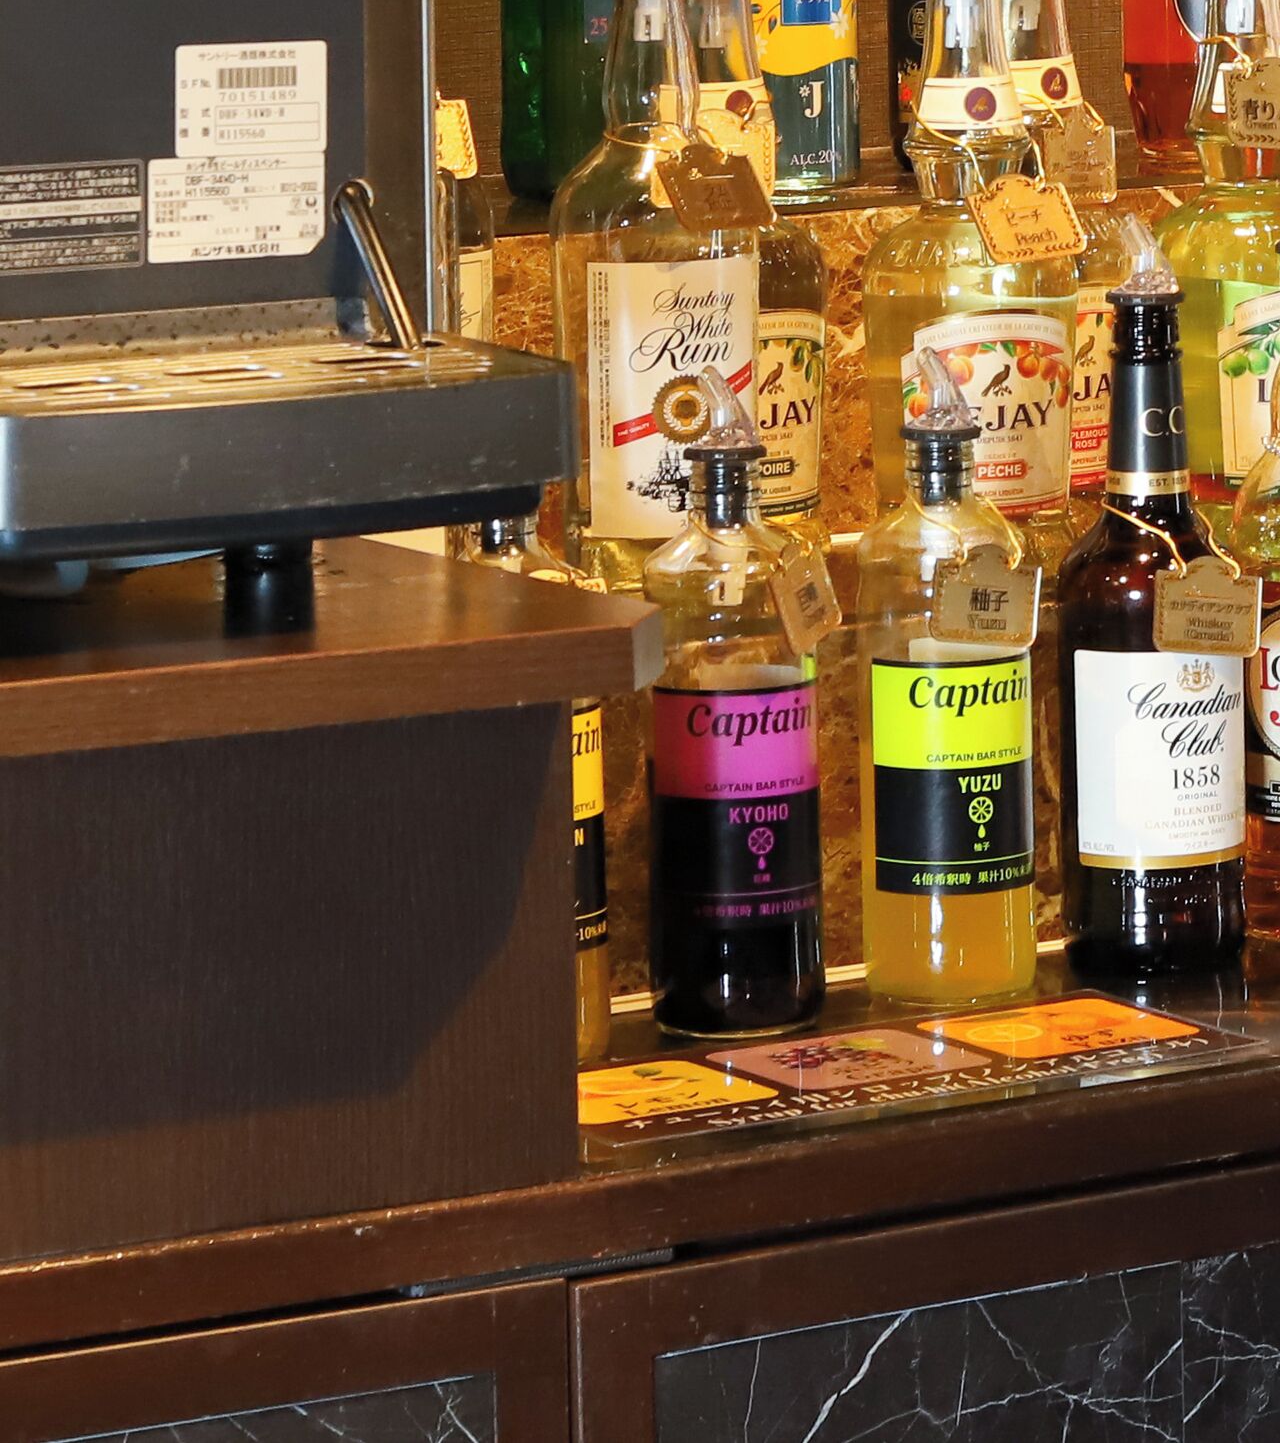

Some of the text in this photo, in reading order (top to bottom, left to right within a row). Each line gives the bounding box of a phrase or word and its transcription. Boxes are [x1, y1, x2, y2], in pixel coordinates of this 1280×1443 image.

[1014, 227, 1058, 246] Peach
[652, 282, 737, 321] Suntory
[673, 310, 734, 343] White
[628, 327, 735, 374] Rum
[760, 395, 817, 431] JAY
[1074, 439, 1098, 450] ROSE
[969, 587, 1010, 613] 柚子
[1185, 618, 1235, 631] Whiskey
[908, 669, 1030, 718] Captain
[1127, 672, 1244, 722] Canadian
[685, 696, 814, 748] Captain
[925, 745, 1023, 764] CAPTAIN BAR STYLE
[755, 780, 777, 791] BAR
[957, 773, 1003, 795] YUZU
[1171, 763, 1222, 791] 1858
[1176, 790, 1219, 802] ORIGINAL
[728, 803, 790, 825] KYOHO
[1173, 803, 1223, 817] BLENDED
